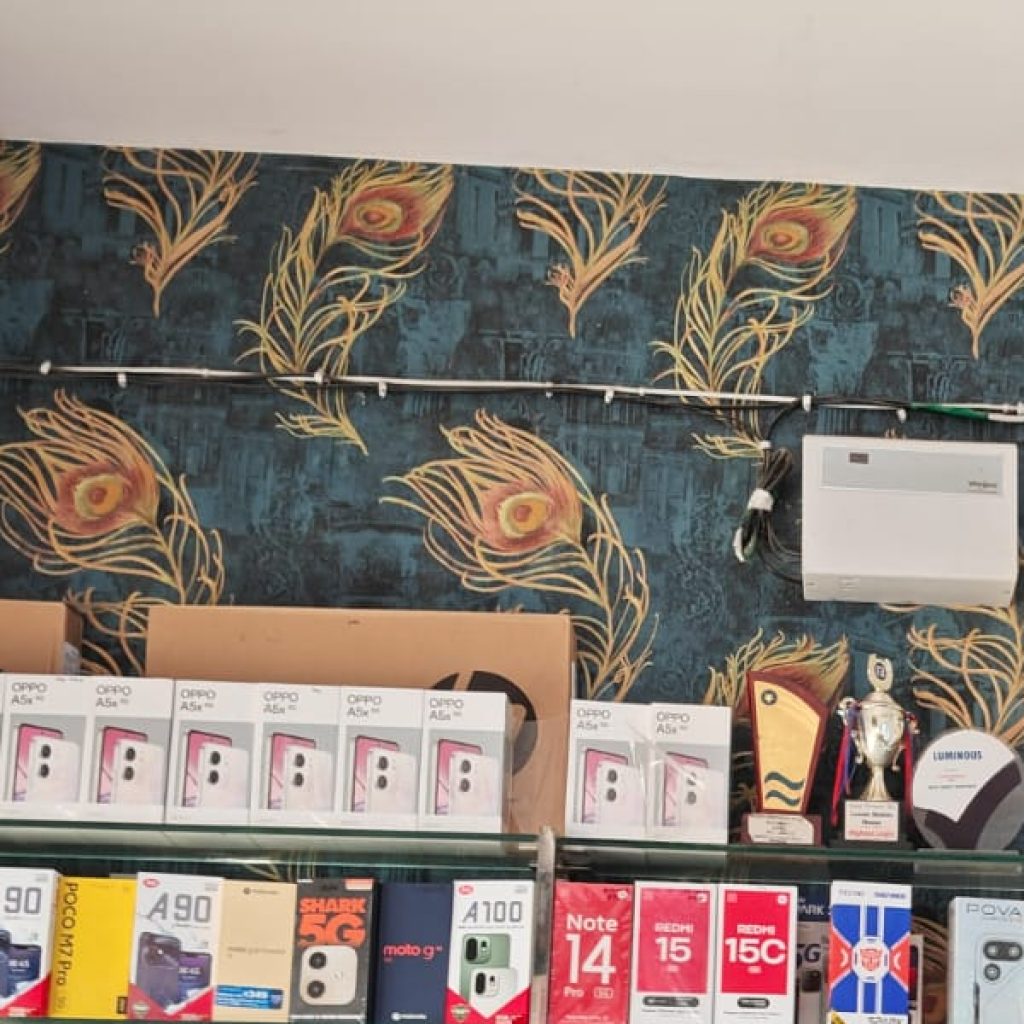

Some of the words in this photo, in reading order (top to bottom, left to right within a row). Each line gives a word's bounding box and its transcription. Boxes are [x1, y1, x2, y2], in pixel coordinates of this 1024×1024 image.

[933, 750, 982, 761] LUMINOUS
[62, 882, 78, 929] POCO
[299, 897, 366, 914] SHARK
[462, 900, 523, 924] A100
[966, 903, 1022, 916] POVA
[299, 914, 366, 946] 5G
[566, 914, 618, 932] Note
[655, 923, 693, 934] REDMI
[737, 924, 775, 935] REDMI
[383, 943, 420, 955] moto
[565, 934, 617, 984] 14
[655, 937, 692, 962] 15
[725, 938, 786, 964] 15C
[56, 961, 72, 986] Pro
